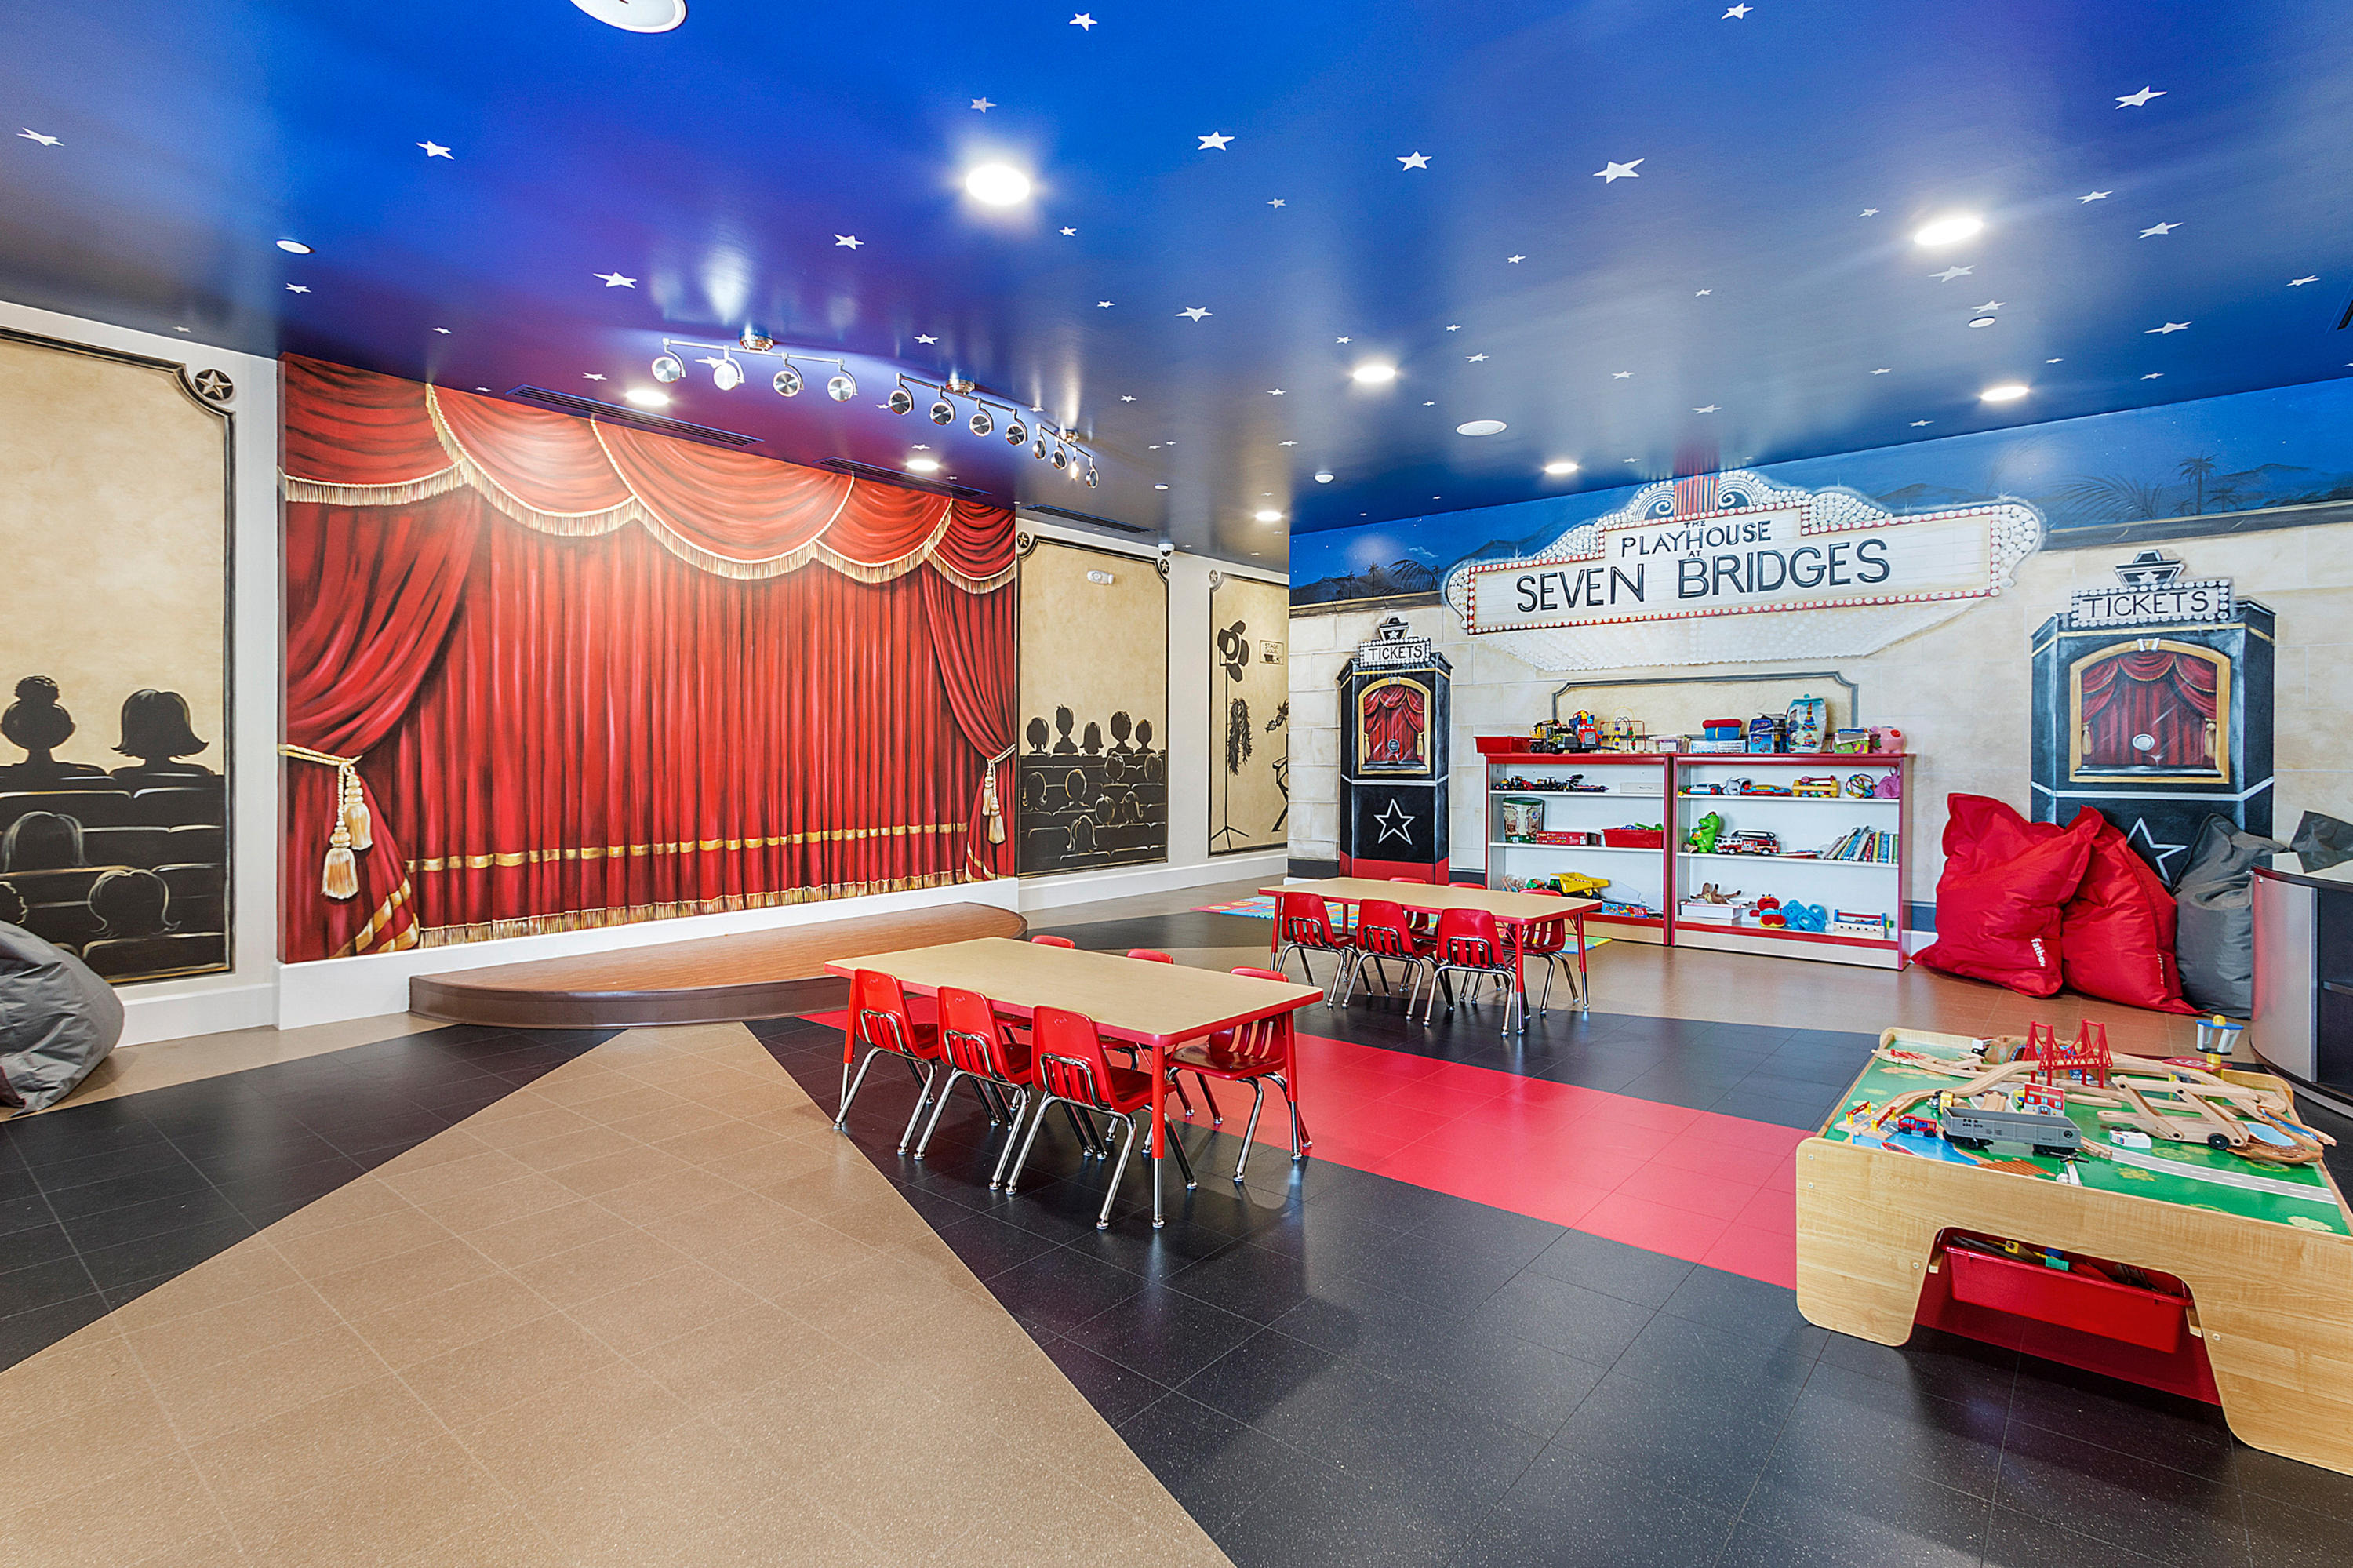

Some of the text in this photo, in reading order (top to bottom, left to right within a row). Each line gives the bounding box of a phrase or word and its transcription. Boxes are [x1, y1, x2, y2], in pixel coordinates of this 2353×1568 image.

[1684, 520, 1706, 529] THE
[1621, 520, 1772, 558] PLAYHOUSE
[1688, 550, 1702, 558] AT
[1516, 538, 1891, 613] SEVEN BRIDGES
[2082, 591, 2209, 618] TICKETS
[1368, 645, 1423, 660] TICKETS
